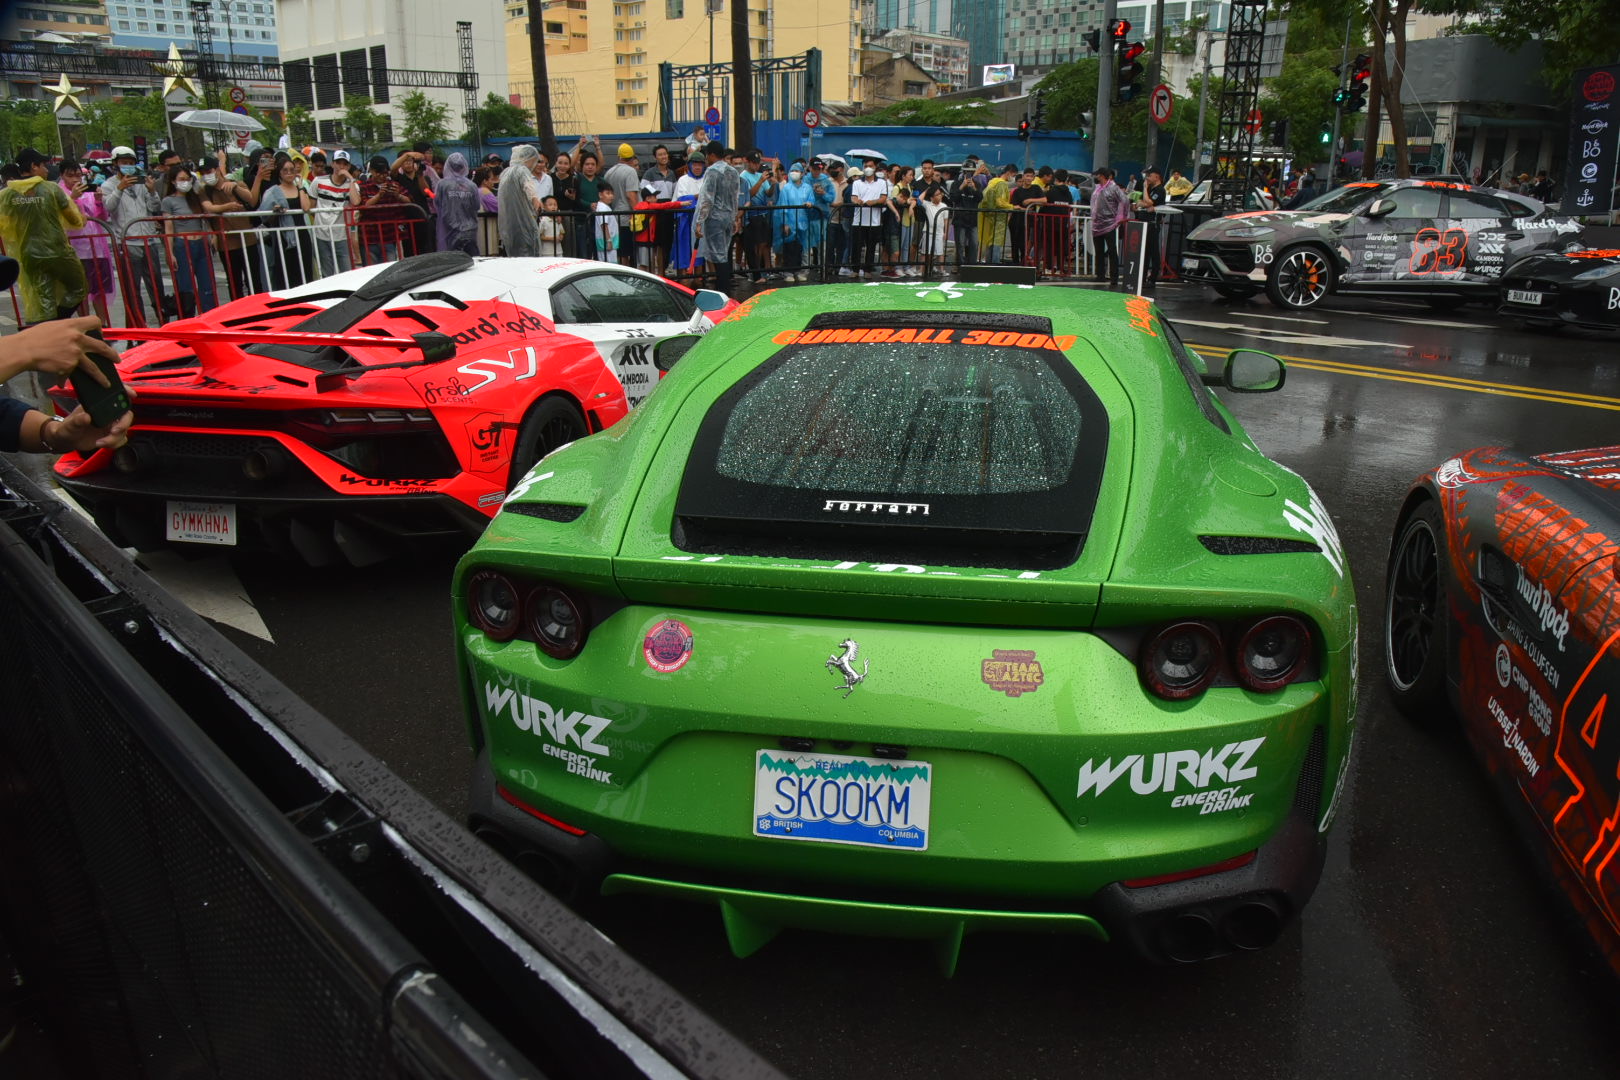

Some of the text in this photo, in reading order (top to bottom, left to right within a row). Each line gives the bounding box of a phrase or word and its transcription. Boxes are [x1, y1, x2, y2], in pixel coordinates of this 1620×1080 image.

[1366, 232, 1398, 243] Hard Rock
[1409, 227, 1469, 276] 83
[771, 328, 1077, 352] GUMBALL 3000
[456, 346, 537, 396] SVJ
[340, 474, 438, 487] WURKZ
[823, 499, 930, 515] Ferrari
[172, 512, 229, 534] GYMKHNA
[1515, 562, 1569, 652] Hard Rock
[1002, 671, 1042, 683] AZTEC
[1006, 662, 1040, 673] TEAM
[1527, 641, 1560, 689] OLUFSEN
[1512, 665, 1529, 696] CHIP
[485, 680, 613, 757] WURKZ
[1528, 701, 1551, 738] GROUP
[1487, 695, 1540, 778] ULYSSE NARDIN
[543, 743, 597, 767] ENERGY
[815, 760, 871, 774] BEAUTIFUL
[566, 761, 613, 785] DRINK
[1077, 736, 1267, 799] WURKZ
[775, 776, 910, 825] SKOOKM
[1171, 785, 1242, 809] ENERGY
[1200, 793, 1255, 815] DRINK
[773, 820, 803, 830] BRITISH
[878, 829, 919, 840] COLUMBIA
